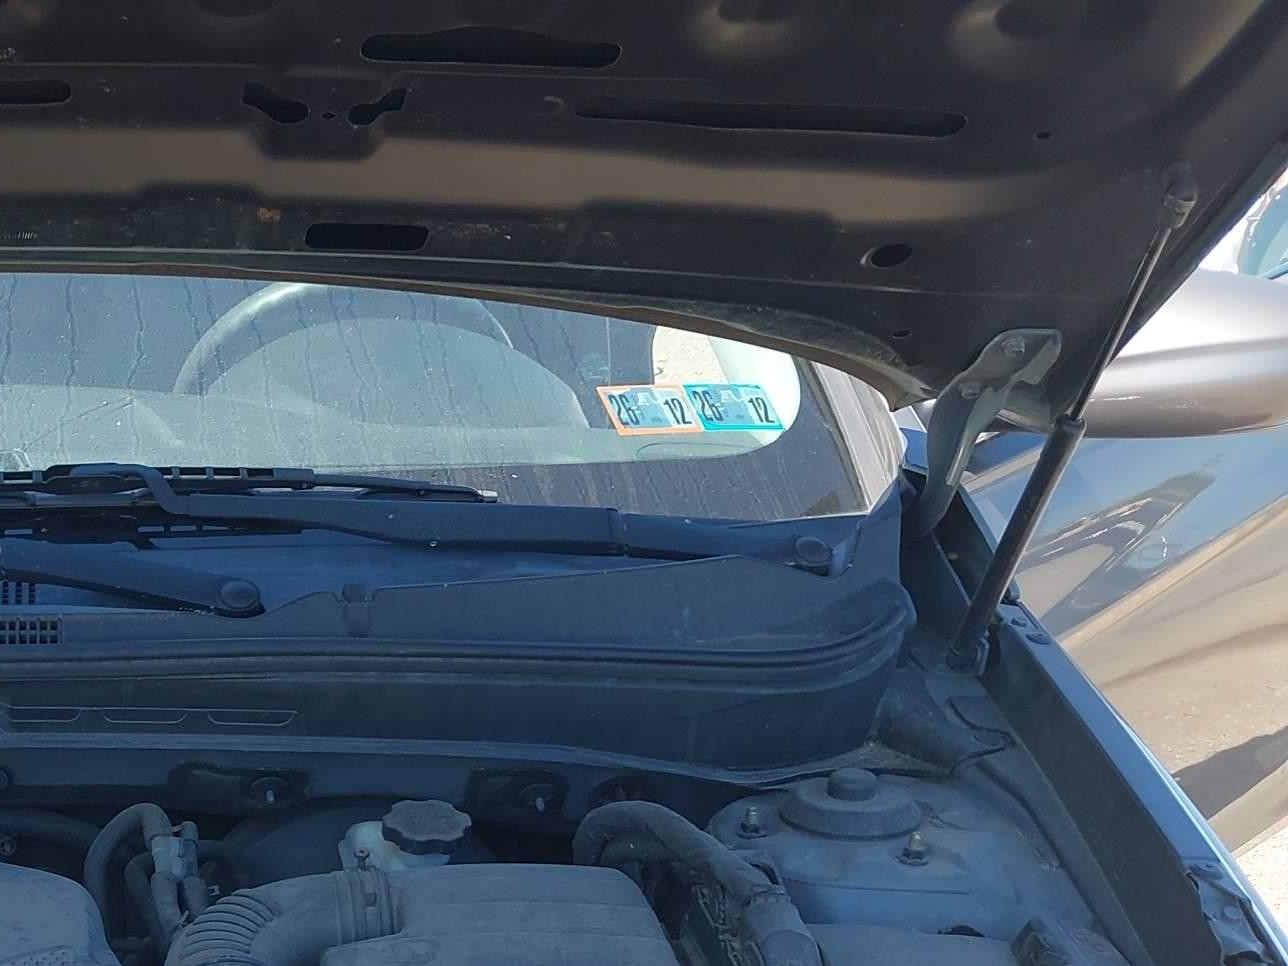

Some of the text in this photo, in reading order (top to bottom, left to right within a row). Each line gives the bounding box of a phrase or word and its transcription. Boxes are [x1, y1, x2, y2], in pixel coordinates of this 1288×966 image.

[608, 394, 692, 426] 26 12
[693, 390, 775, 424] 26 12
